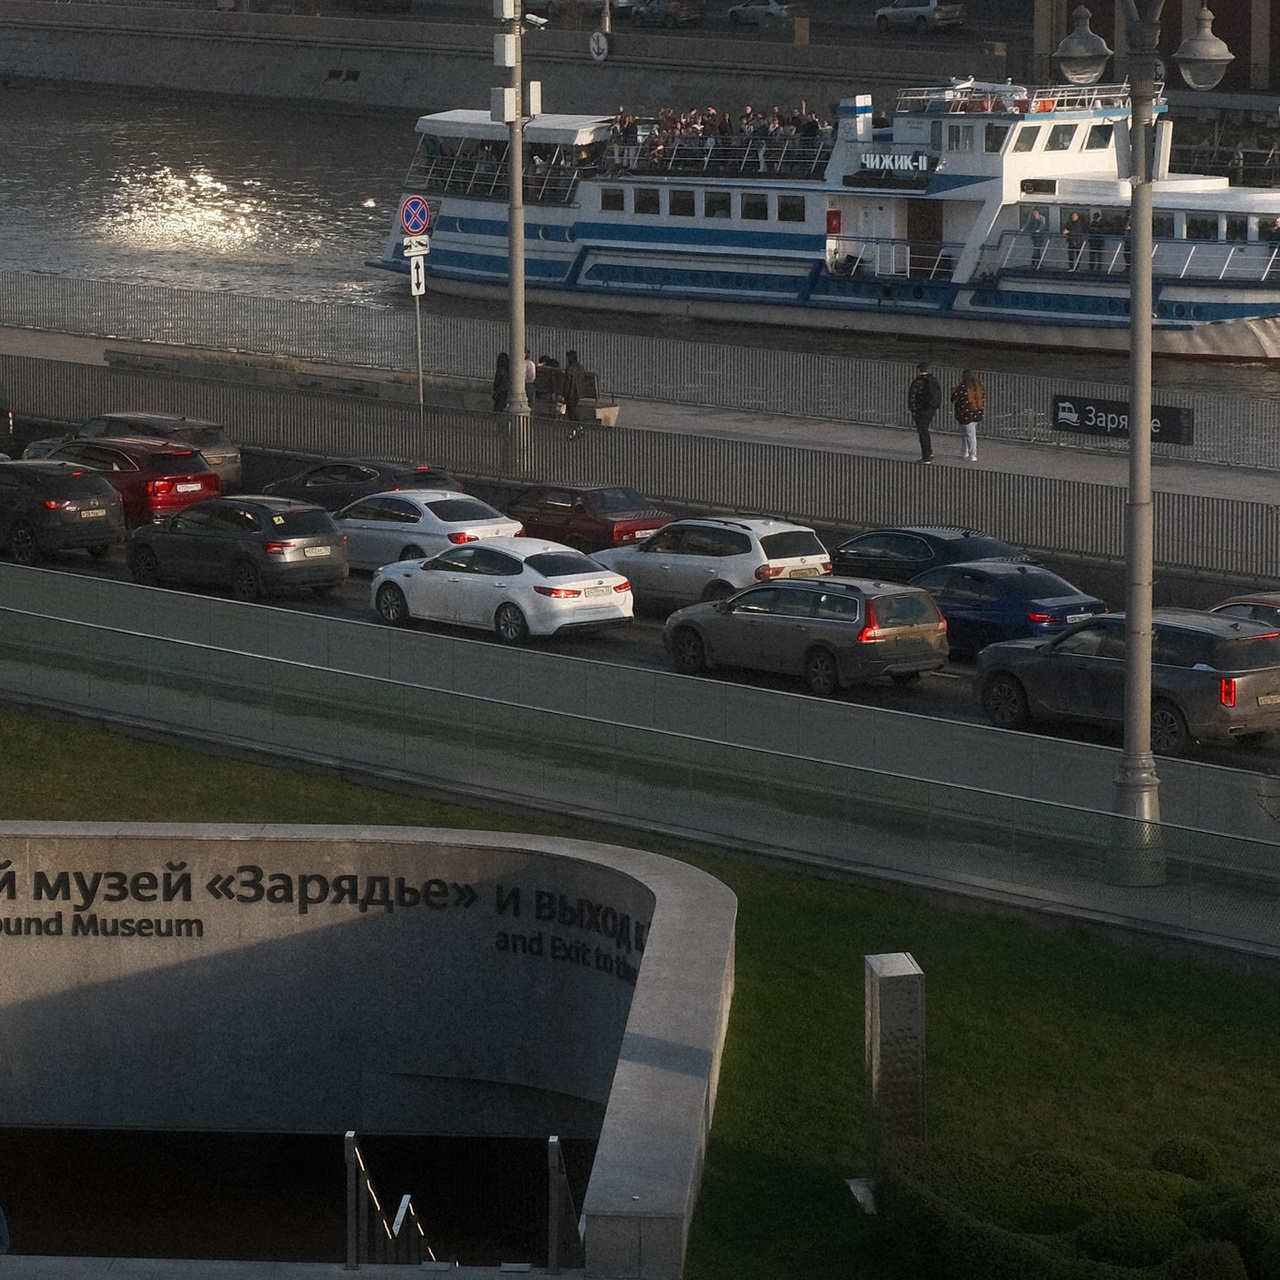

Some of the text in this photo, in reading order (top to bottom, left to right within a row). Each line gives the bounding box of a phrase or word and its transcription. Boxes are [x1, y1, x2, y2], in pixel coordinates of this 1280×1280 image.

[1084, 405, 1162, 433] Заряе
[33, 860, 192, 913] музей
[204, 864, 479, 915] «Зарядье»
[70, 910, 205, 938] Museum
[494, 930, 543, 957] and
[550, 935, 592, 967] Exit
